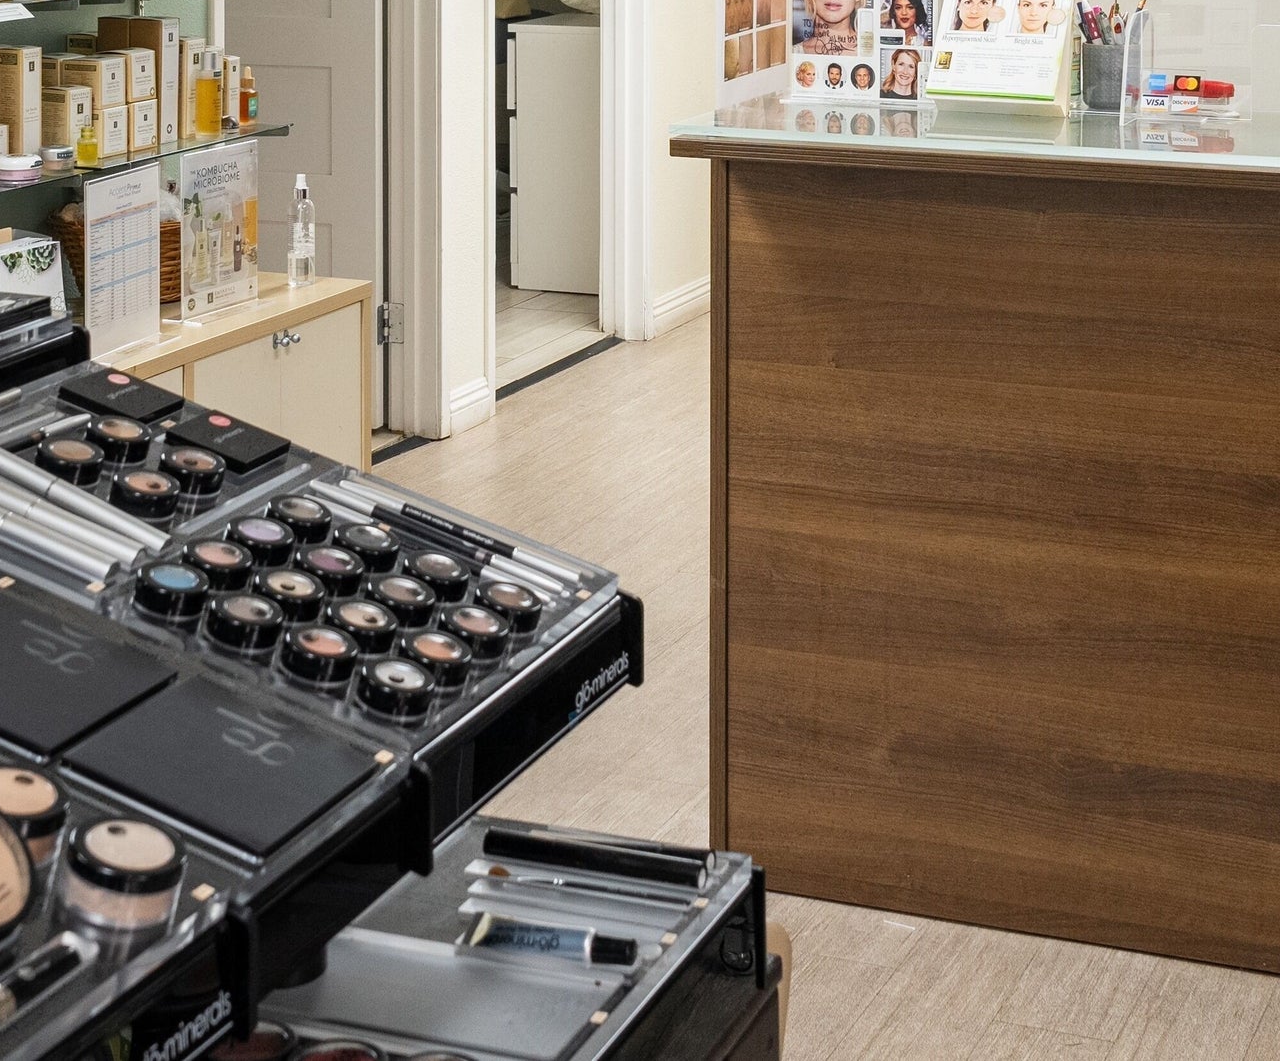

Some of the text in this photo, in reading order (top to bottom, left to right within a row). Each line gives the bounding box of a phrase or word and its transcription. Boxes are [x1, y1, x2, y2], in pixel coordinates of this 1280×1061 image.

[942, 34, 982, 43] Hyperpigmented
[196, 161, 238, 178] KOMBUCHA
[193, 171, 240, 190] MICROBIOME
